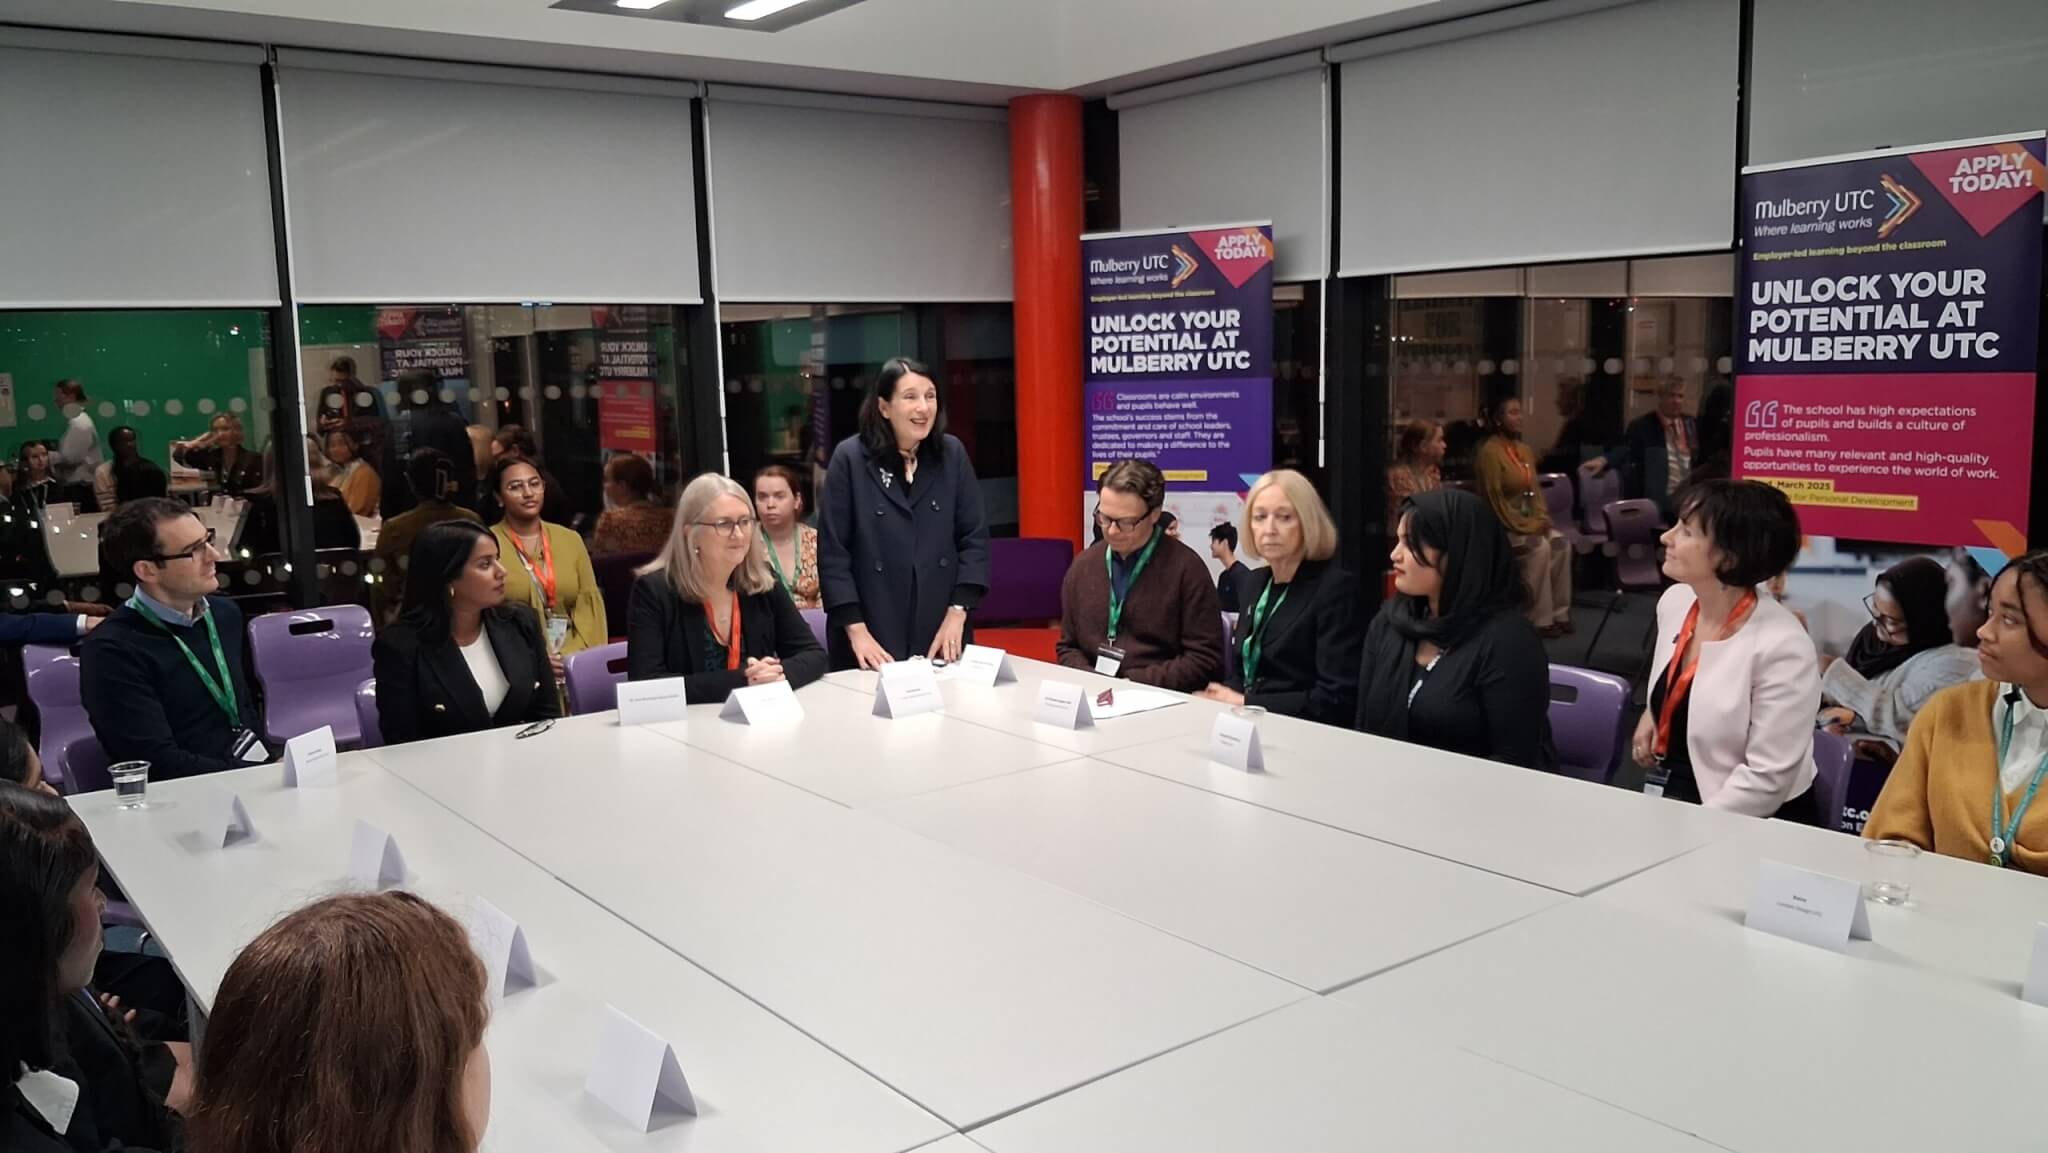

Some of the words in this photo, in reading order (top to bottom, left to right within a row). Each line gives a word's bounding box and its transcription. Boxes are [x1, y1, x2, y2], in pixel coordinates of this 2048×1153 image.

[1955, 152, 2028, 176] APPLY
[1949, 170, 2033, 194] TODAY!
[1755, 198, 1831, 220] Mulberry
[1835, 189, 1875, 212] UTC
[1754, 223, 1788, 237] Where
[1790, 219, 1835, 234] learning
[1838, 216, 1873, 229] works
[1218, 233, 1261, 248] APPLY
[1214, 245, 1266, 260] TODAY!
[1753, 250, 1807, 261] Employer-led
[1809, 247, 1845, 257] learning
[1846, 244, 1880, 254] beyond
[1882, 242, 1897, 251] the
[1899, 239, 1947, 250] classroom
[1090, 259, 1140, 276] Mulberry
[1143, 255, 1168, 270] UTC
[1115, 275, 1145, 285] learning
[1146, 274, 1168, 282] works
[1752, 274, 1882, 306] UNLOCK
[1888, 269, 1986, 298] YOUR
[1091, 312, 1176, 333] UNLOCK
[1180, 309, 1240, 330] YOUR
[1750, 304, 1929, 334] POTENTIAL
[1936, 300, 1984, 328] AT
[1091, 333, 1207, 353] POTENTIAL
[1212, 331, 1240, 349] AT
[1748, 334, 1922, 362] MULBERRY
[1929, 332, 2000, 360] UTC
[1091, 352, 1203, 373] MULBERRY
[1208, 351, 1250, 370] UTC
[1190, 391, 1240, 399] environments
[1131, 402, 1153, 411] pupils
[1154, 401, 1180, 409] behave
[1783, 404, 1803, 415] The
[1806, 404, 1843, 416] school
[1846, 405, 1866, 416] has
[1869, 405, 1895, 417] high
[1898, 406, 1976, 418] expectations
[1186, 412, 1204, 420] from
[1205, 412, 1218, 420] the
[1178, 422, 1203, 430] school
[1781, 418, 1794, 428] of
[1796, 418, 1830, 430] pupils
[1833, 418, 1855, 429] and
[1857, 419, 1893, 430] builds
[1895, 422, 1903, 430] a
[1906, 419, 1949, 431] culture
[1952, 420, 1966, 431] of
[1121, 433, 1158, 441] governors
[1194, 431, 1212, 440] They
[1744, 430, 1830, 442] professionalism.
[1091, 441, 1127, 449] dedicated
[1127, 441, 1136, 449] to
[1136, 441, 1163, 450] making
[1170, 441, 1207, 449] difference
[1217, 441, 1230, 449] the
[1091, 450, 1107, 458] lives
[1107, 450, 1116, 458] of
[1116, 450, 1134, 458] their
[1743, 446, 1774, 458] Pupils
[1776, 447, 1803, 458] have
[1805, 449, 1837, 461] many
[1840, 449, 1886, 460] relevant
[1889, 450, 1912, 461] and
[1915, 451, 1989, 466] high-quality
[1743, 460, 1811, 472] opportunities
[1814, 462, 1826, 472] to
[1828, 463, 1890, 475] experience
[1892, 465, 1912, 475] the
[1914, 466, 1947, 477] world
[1950, 467, 1964, 477] of
[1966, 468, 2000, 479] work.
[1776, 480, 1804, 489] March
[1807, 481, 1831, 490] 2025
[1794, 492, 1808, 500] for
[1809, 493, 1849, 504] Personal
[1851, 495, 1915, 507] Development
